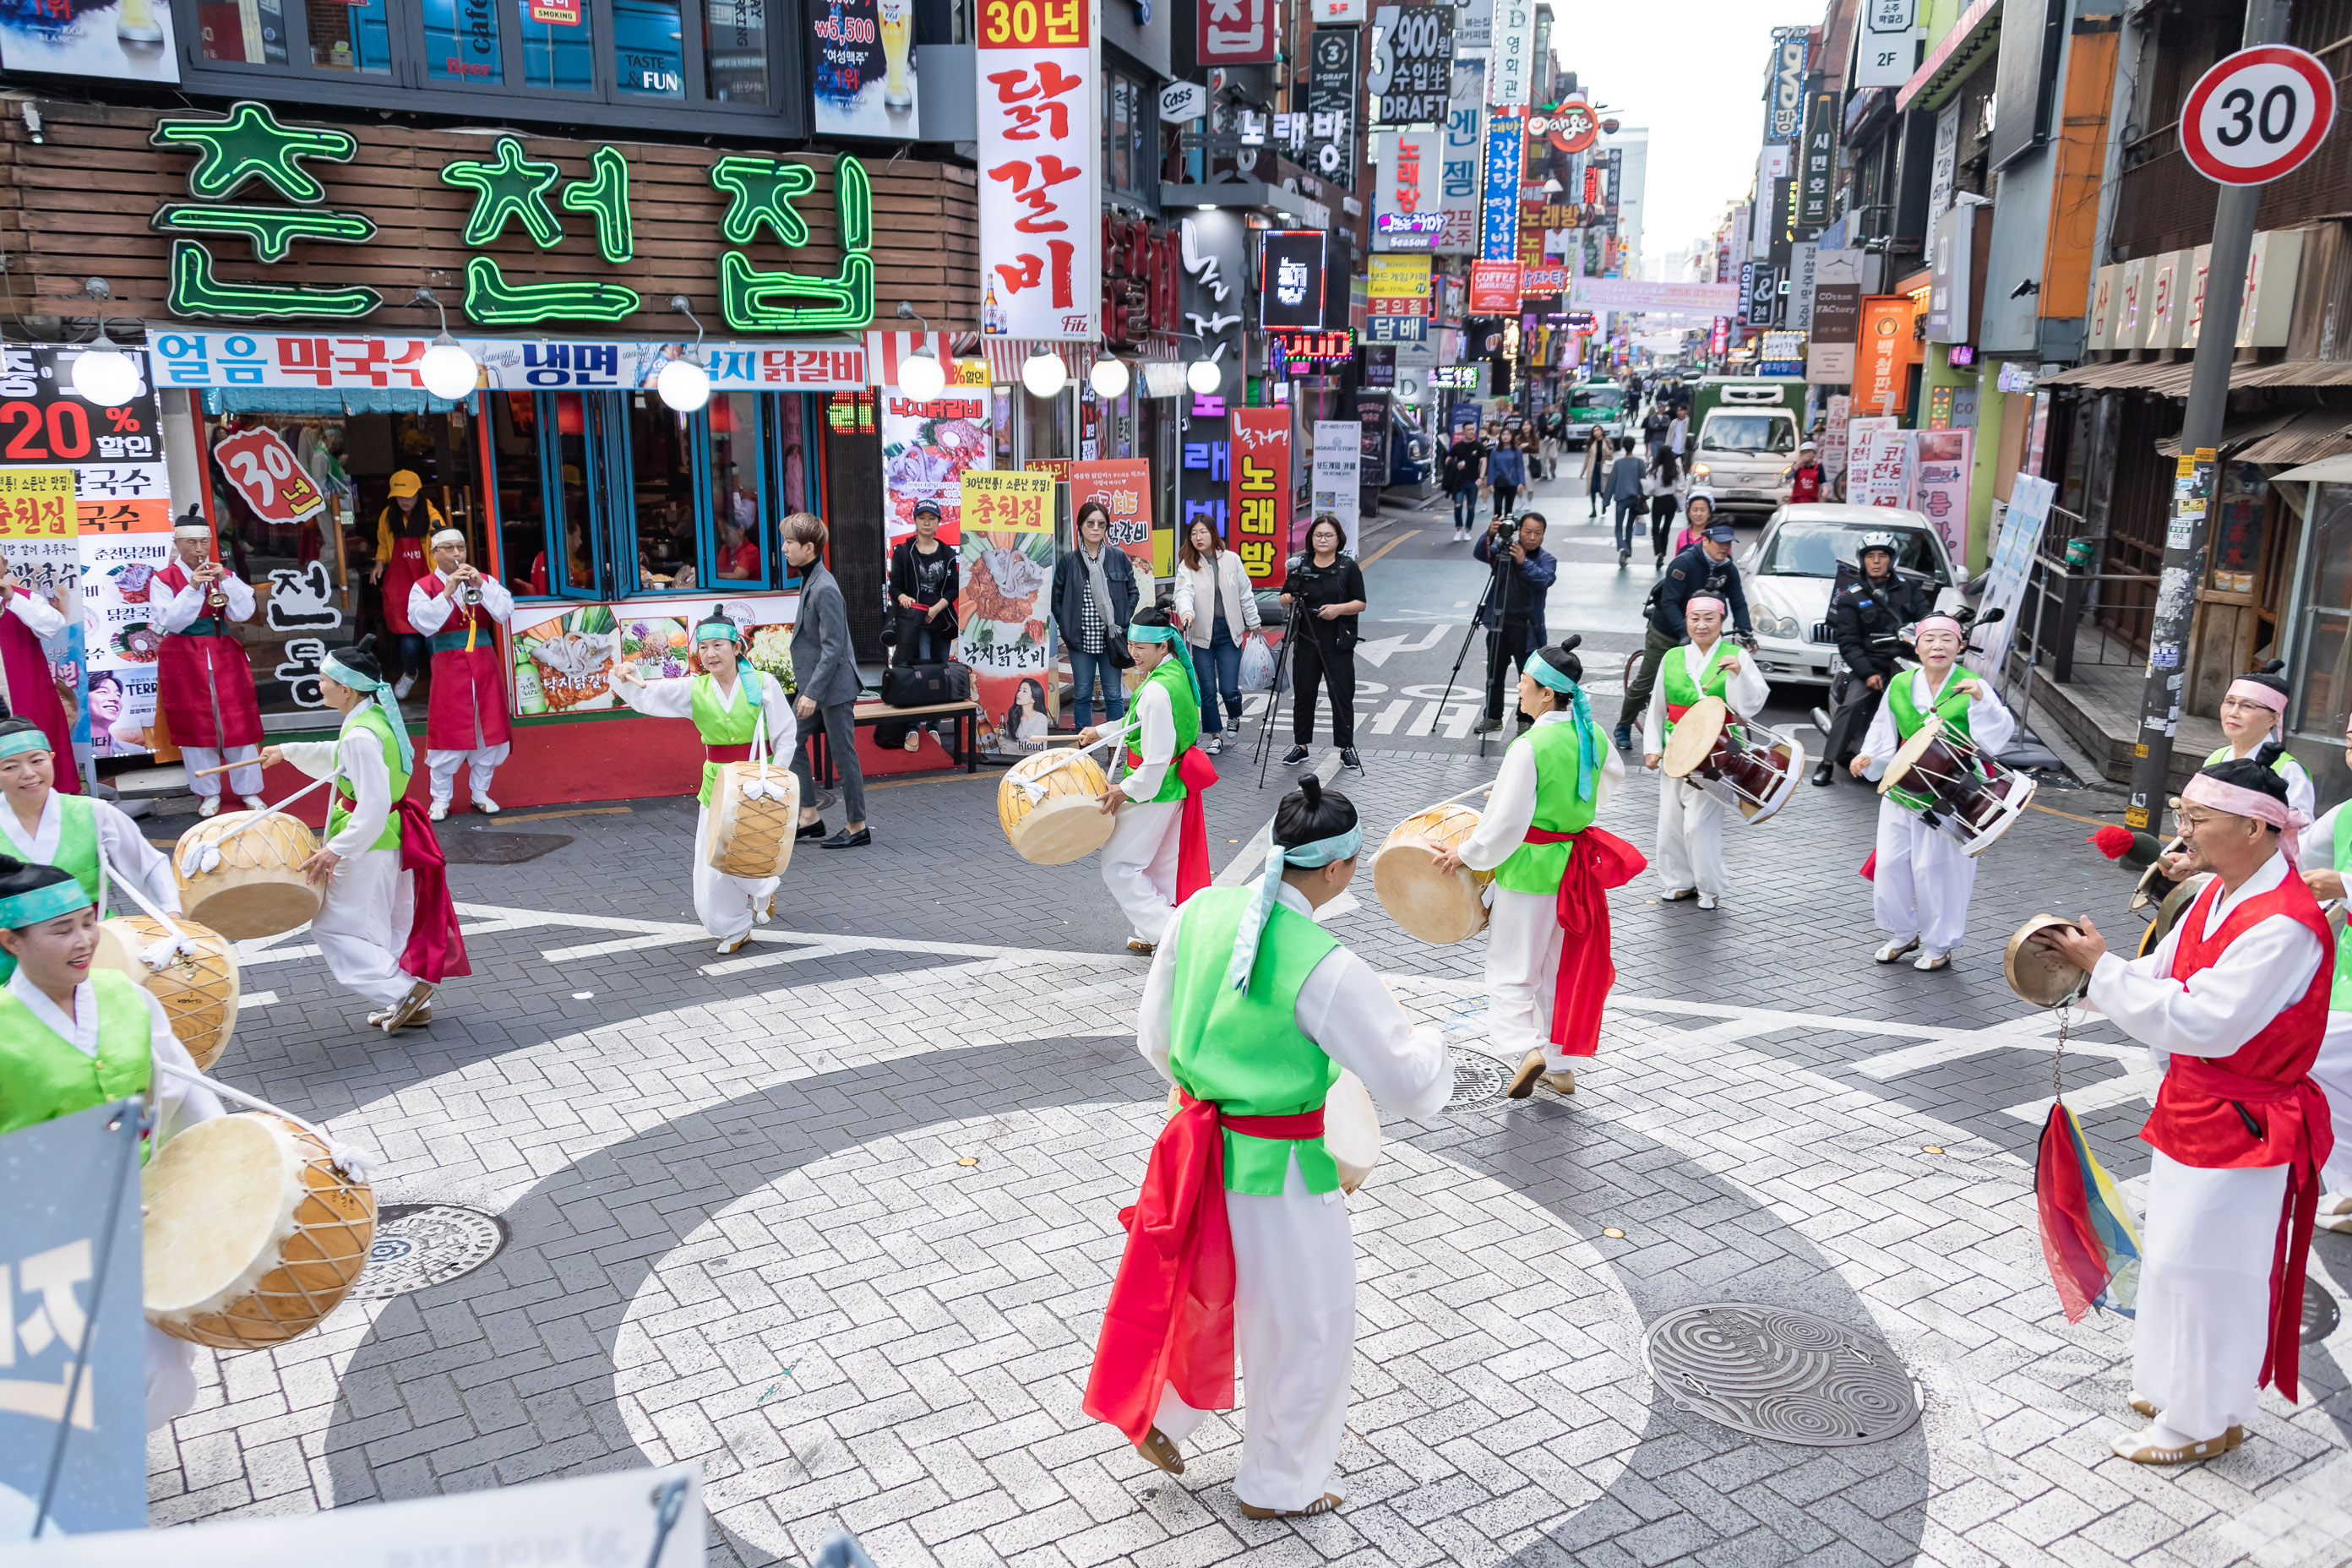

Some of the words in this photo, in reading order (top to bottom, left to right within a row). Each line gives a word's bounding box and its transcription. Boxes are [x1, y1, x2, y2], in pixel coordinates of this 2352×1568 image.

[538, 10, 573, 20] SMOKING
[1329, 3, 1349, 14] 3F
[1882, 3, 1900, 14] 소주
[985, 0, 1080, 44] 30년
[626, 54, 665, 70] TASTE
[1327, 45, 1339, 62] 3
[1876, 52, 1897, 67] 2F
[446, 57, 492, 77] Beer
[629, 72, 641, 86] &
[643, 71, 678, 91] FUN
[836, 68, 858, 90] 1위
[1381, 95, 1447, 120] DRAFT
[2217, 84, 2297, 147] 30
[1240, 110, 1343, 172] 노래방
[1396, 136, 1420, 213] 노래방
[1806, 133, 1830, 216] 시민호프
[147, 99, 876, 331] 춘천집
[1521, 204, 1581, 228] 노래방
[1389, 236, 1429, 247] Season
[1429, 234, 1440, 247] 2
[1474, 271, 1516, 282] COFFEE
[1738, 264, 1752, 313] COFFEE
[1375, 298, 1422, 315] 편의점
[1061, 314, 1088, 333] Fitz
[1374, 317, 1421, 340] 담배
[157, 335, 268, 386] 얼음
[521, 343, 618, 387] 냉면
[763, 351, 863, 383] 닭갈비
[965, 370, 984, 384] 할인
[889, 397, 983, 421] 낙지닭갈비
[96, 435, 154, 458] 할인
[22, 476, 47, 492] 소문난
[52, 476, 71, 492] 맛집!
[230, 444, 324, 516] 30년
[965, 476, 1004, 491] 30년전통!
[1006, 477, 1030, 492] 소문난
[1032, 478, 1051, 492] 맛집!
[971, 493, 1043, 528] 춘천집
[1239, 455, 1277, 578] 노래방
[95, 546, 166, 561] 춘천닭갈비
[12, 561, 78, 591] 막국수
[1226, 574, 1238, 588] K
[737, 617, 756, 626] MENU
[268, 561, 341, 708] 전통
[963, 642, 1047, 669] 낙지닭갈비
